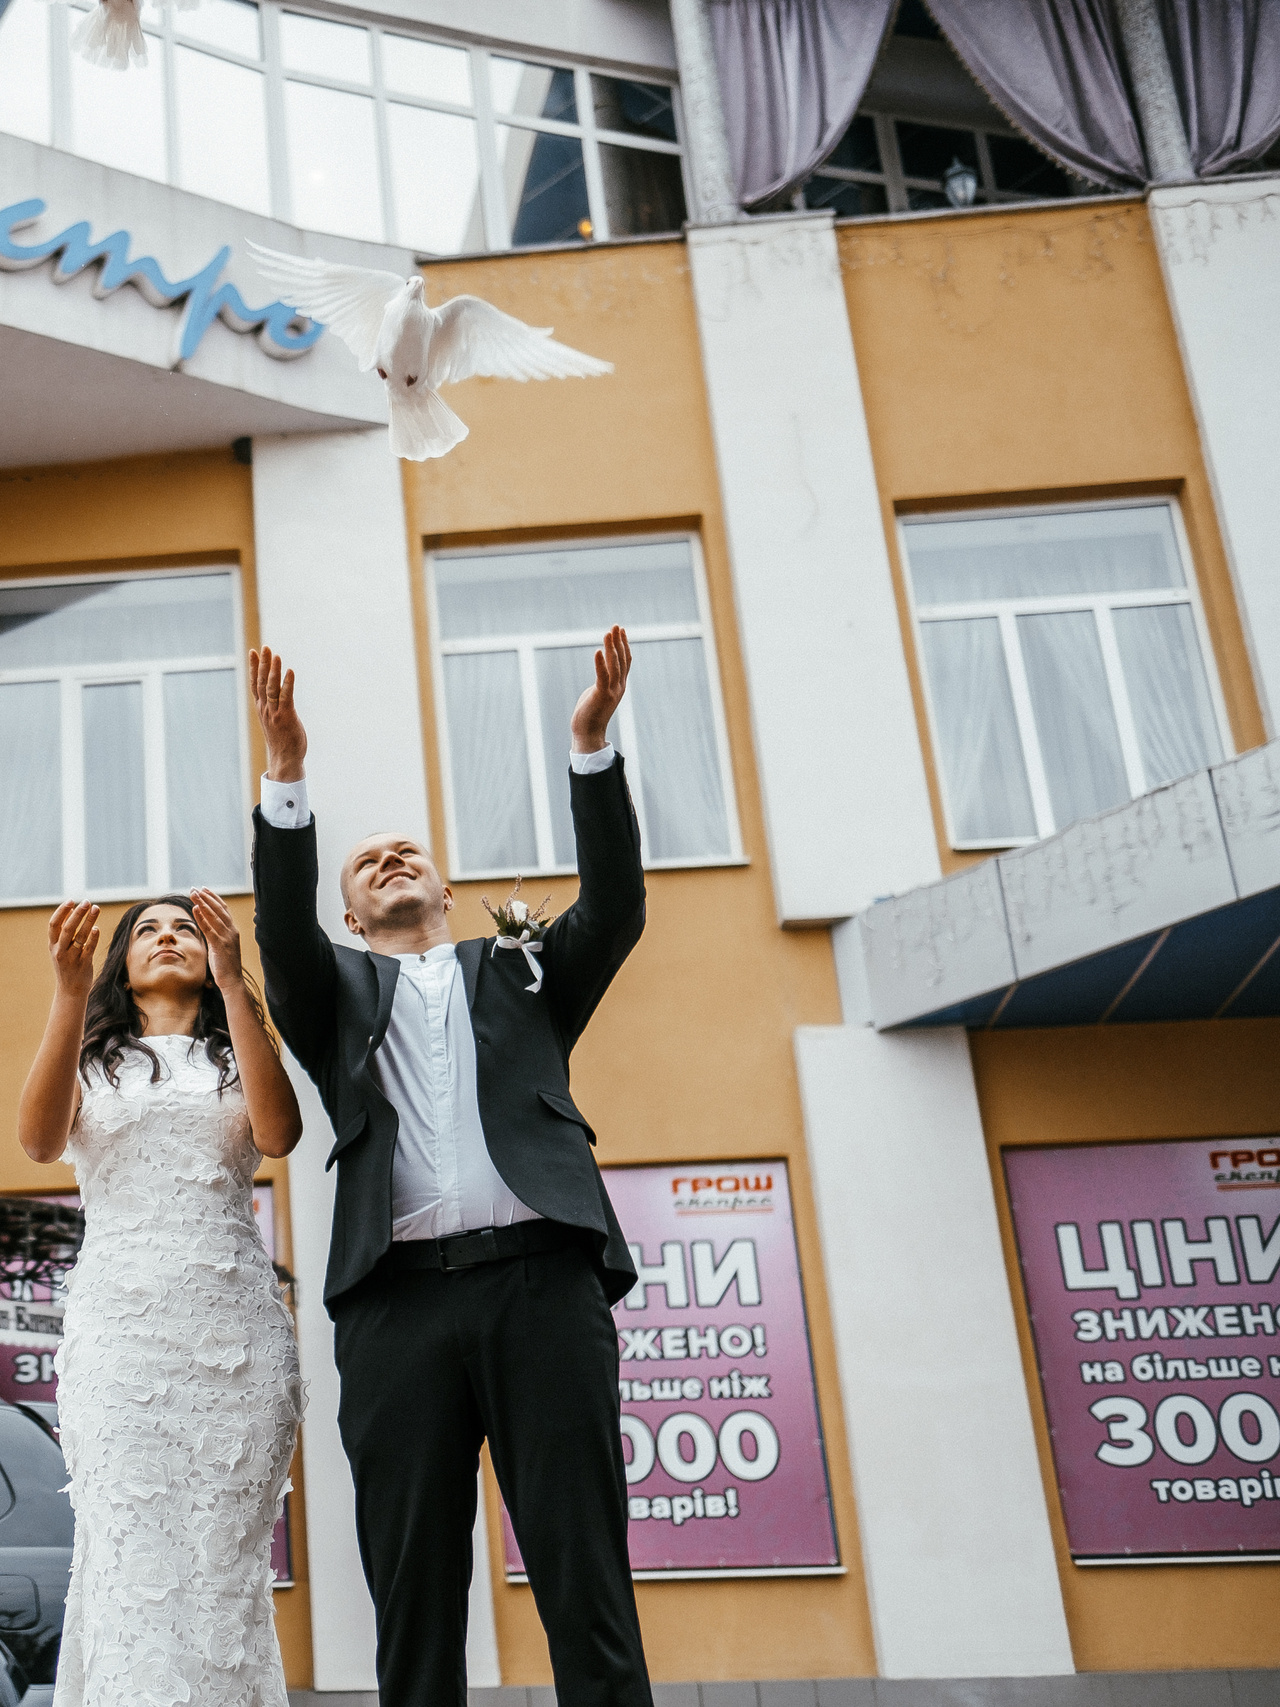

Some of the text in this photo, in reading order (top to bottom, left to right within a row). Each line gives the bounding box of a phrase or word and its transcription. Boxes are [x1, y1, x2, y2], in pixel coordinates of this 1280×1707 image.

[1209, 1148, 1280, 1170] ГРО
[671, 1175, 773, 1195] ГРОШ
[622, 1239, 762, 1311] НИ
[1072, 1303, 1280, 1342] ЗНИЖЕН
[618, 1323, 768, 1361] ЖЕНО!
[619, 1368, 772, 1401] льше ніж
[1080, 1360, 1126, 1384] на
[1131, 1351, 1263, 1383] більше
[620, 1409, 781, 1485] 000
[1088, 1391, 1280, 1468] 300
[628, 1486, 740, 1526] варів!
